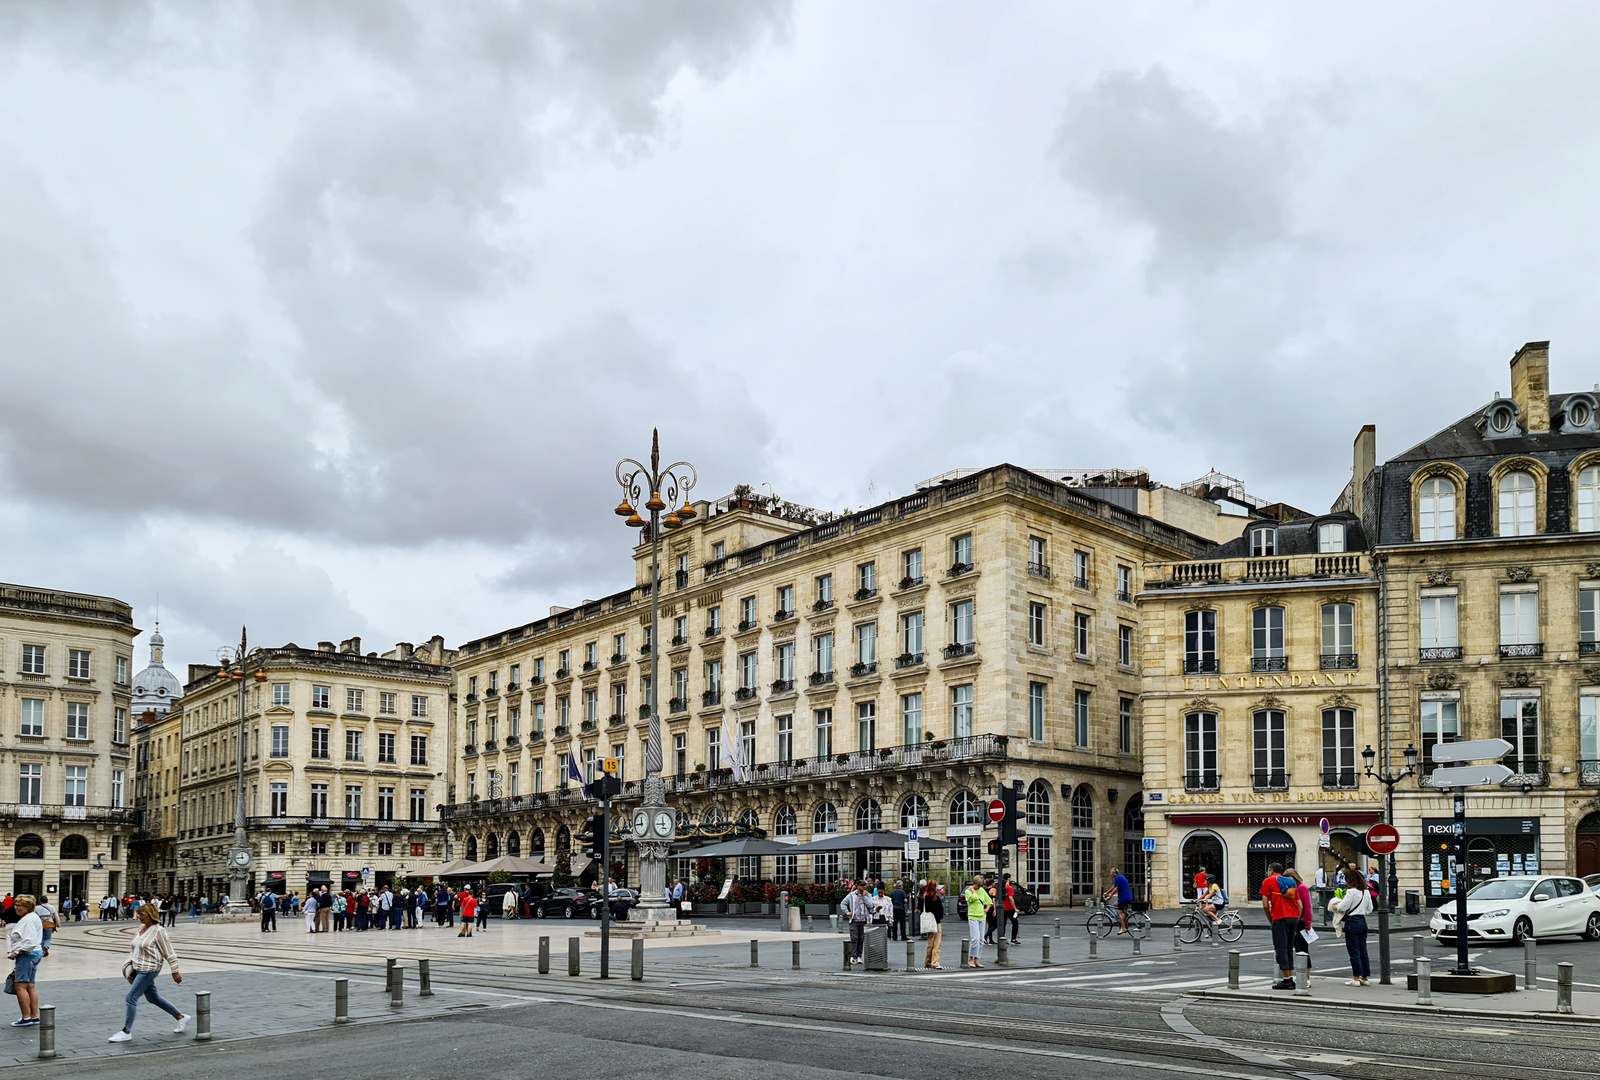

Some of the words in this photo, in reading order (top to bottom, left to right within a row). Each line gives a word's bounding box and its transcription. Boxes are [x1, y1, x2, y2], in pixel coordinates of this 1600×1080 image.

[607, 761, 616, 770] 15
[1168, 793, 1225, 804] GRANDS
[1232, 792, 1265, 803] VINS
[1272, 792, 1291, 803] DE
[1297, 791, 1379, 802] BORDEAUX
[1238, 816, 1310, 824] L'INTENDANT
[1428, 824, 1455, 833] nexit
